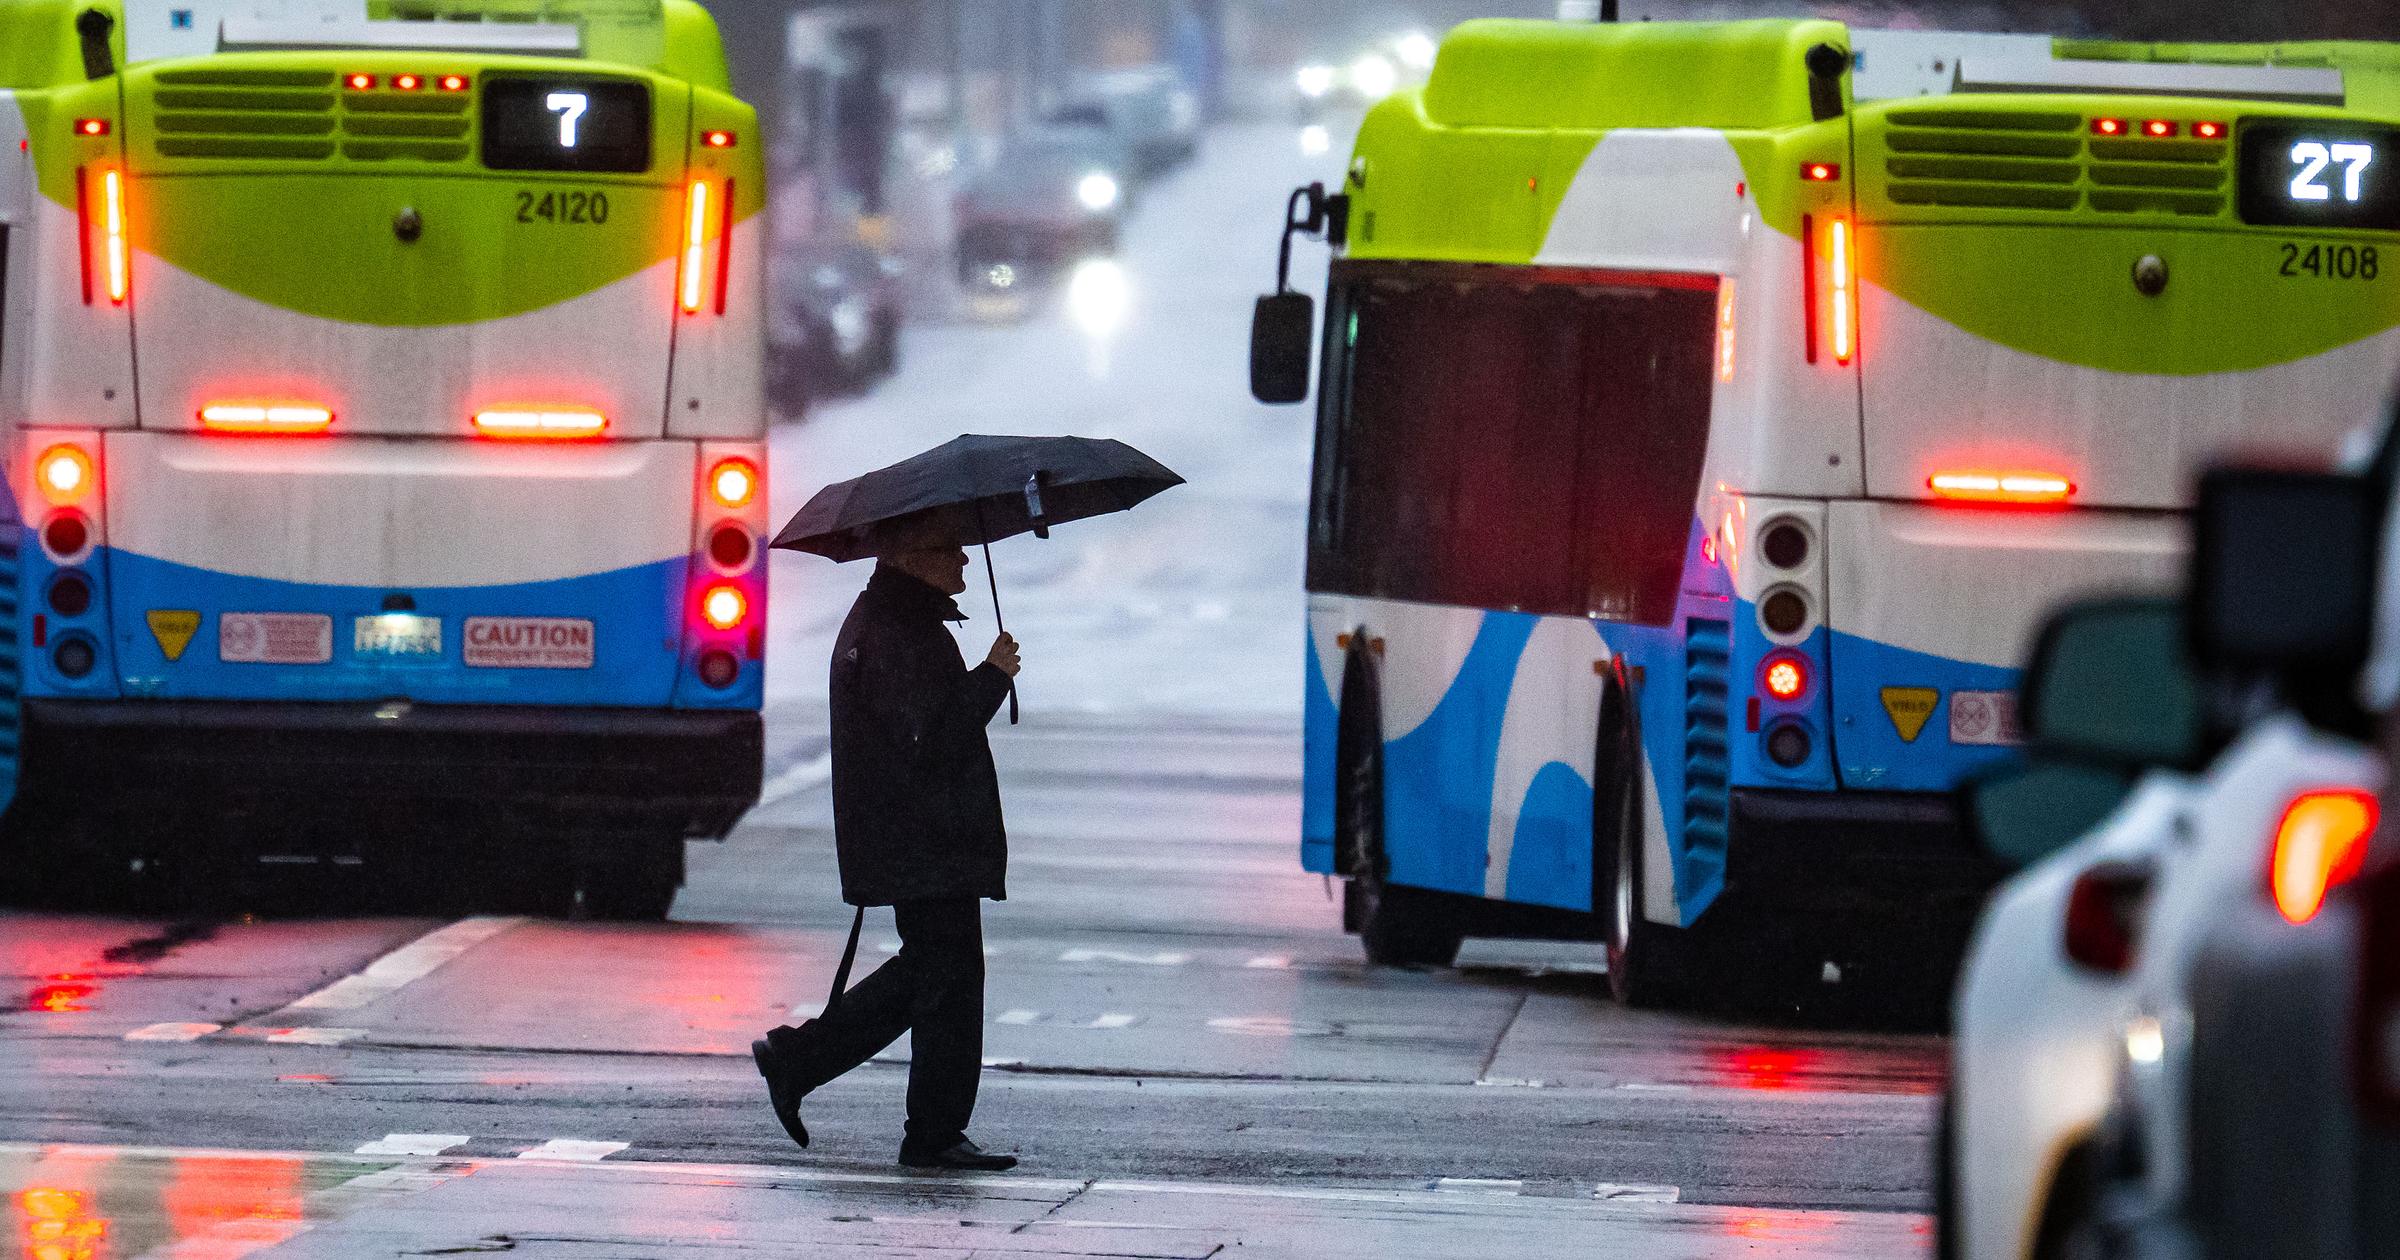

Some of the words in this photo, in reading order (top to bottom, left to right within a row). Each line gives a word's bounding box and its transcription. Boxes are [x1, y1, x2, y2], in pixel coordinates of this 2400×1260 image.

[546, 93, 587, 147] 7
[2291, 142, 2372, 201] 27
[516, 191, 608, 224] 24120
[2280, 243, 2379, 281] 24108
[469, 623, 589, 646] CAUTION
